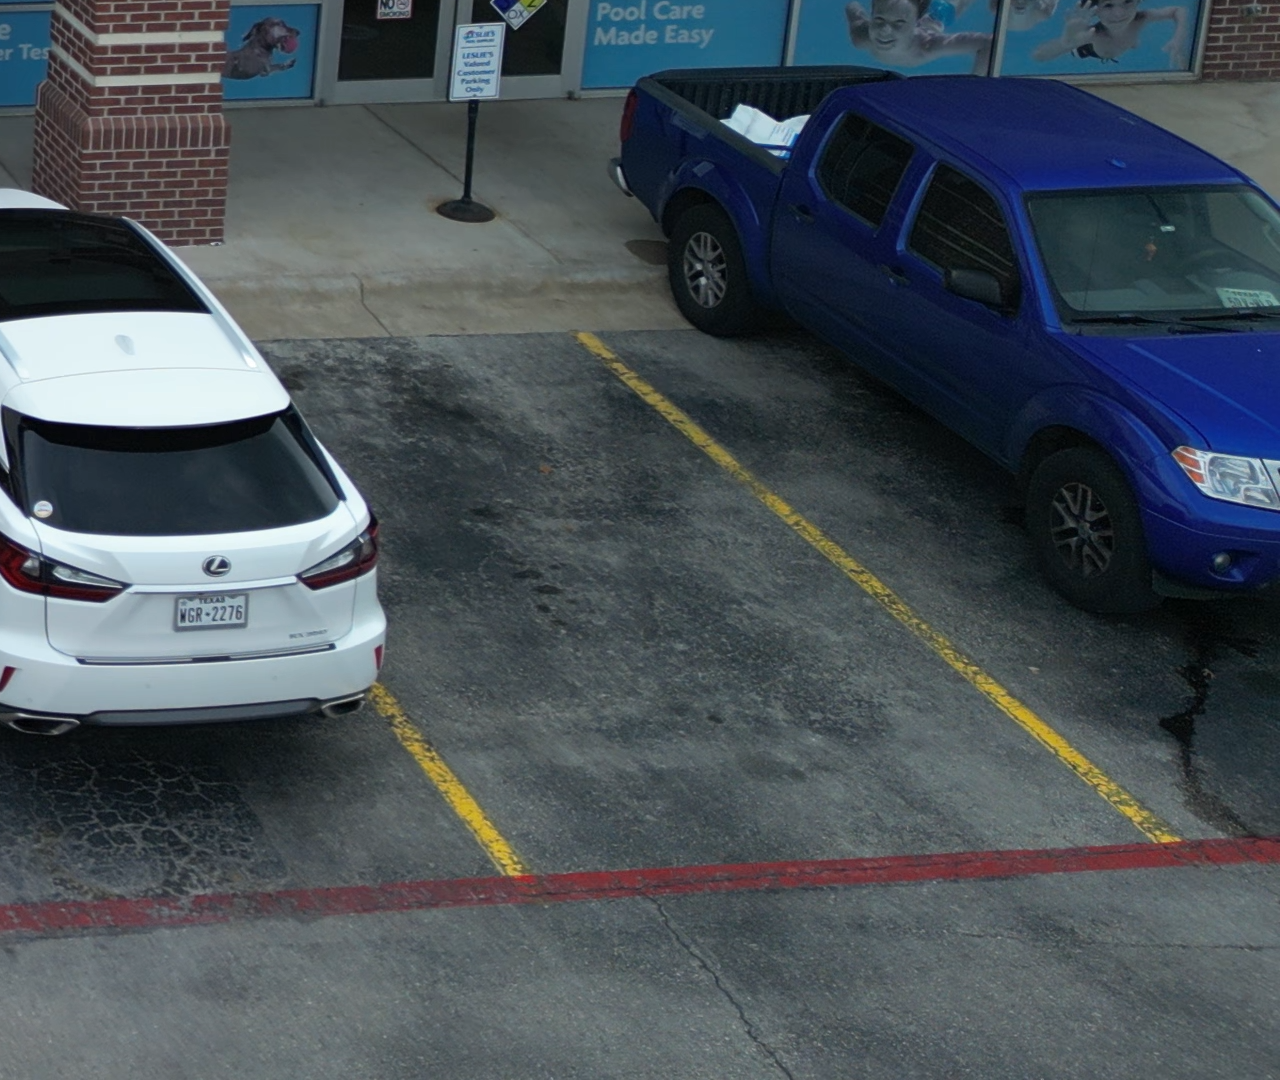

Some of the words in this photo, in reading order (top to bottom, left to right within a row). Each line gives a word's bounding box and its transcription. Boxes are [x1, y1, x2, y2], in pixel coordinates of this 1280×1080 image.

[507, 9, 526, 20] OX
[597, 0, 646, 21] Pool
[653, 0, 705, 20] Care
[593, 24, 658, 46] Made
[664, 24, 714, 49] Easy
[18, 43, 49, 60] Tes
[462, 51, 494, 60] LESLIE'S
[463, 60, 490, 68] Valued
[457, 69, 495, 77] Customer
[461, 77, 491, 86] Parking
[465, 86, 485, 94] Only
[199, 596, 226, 605] TEXAS
